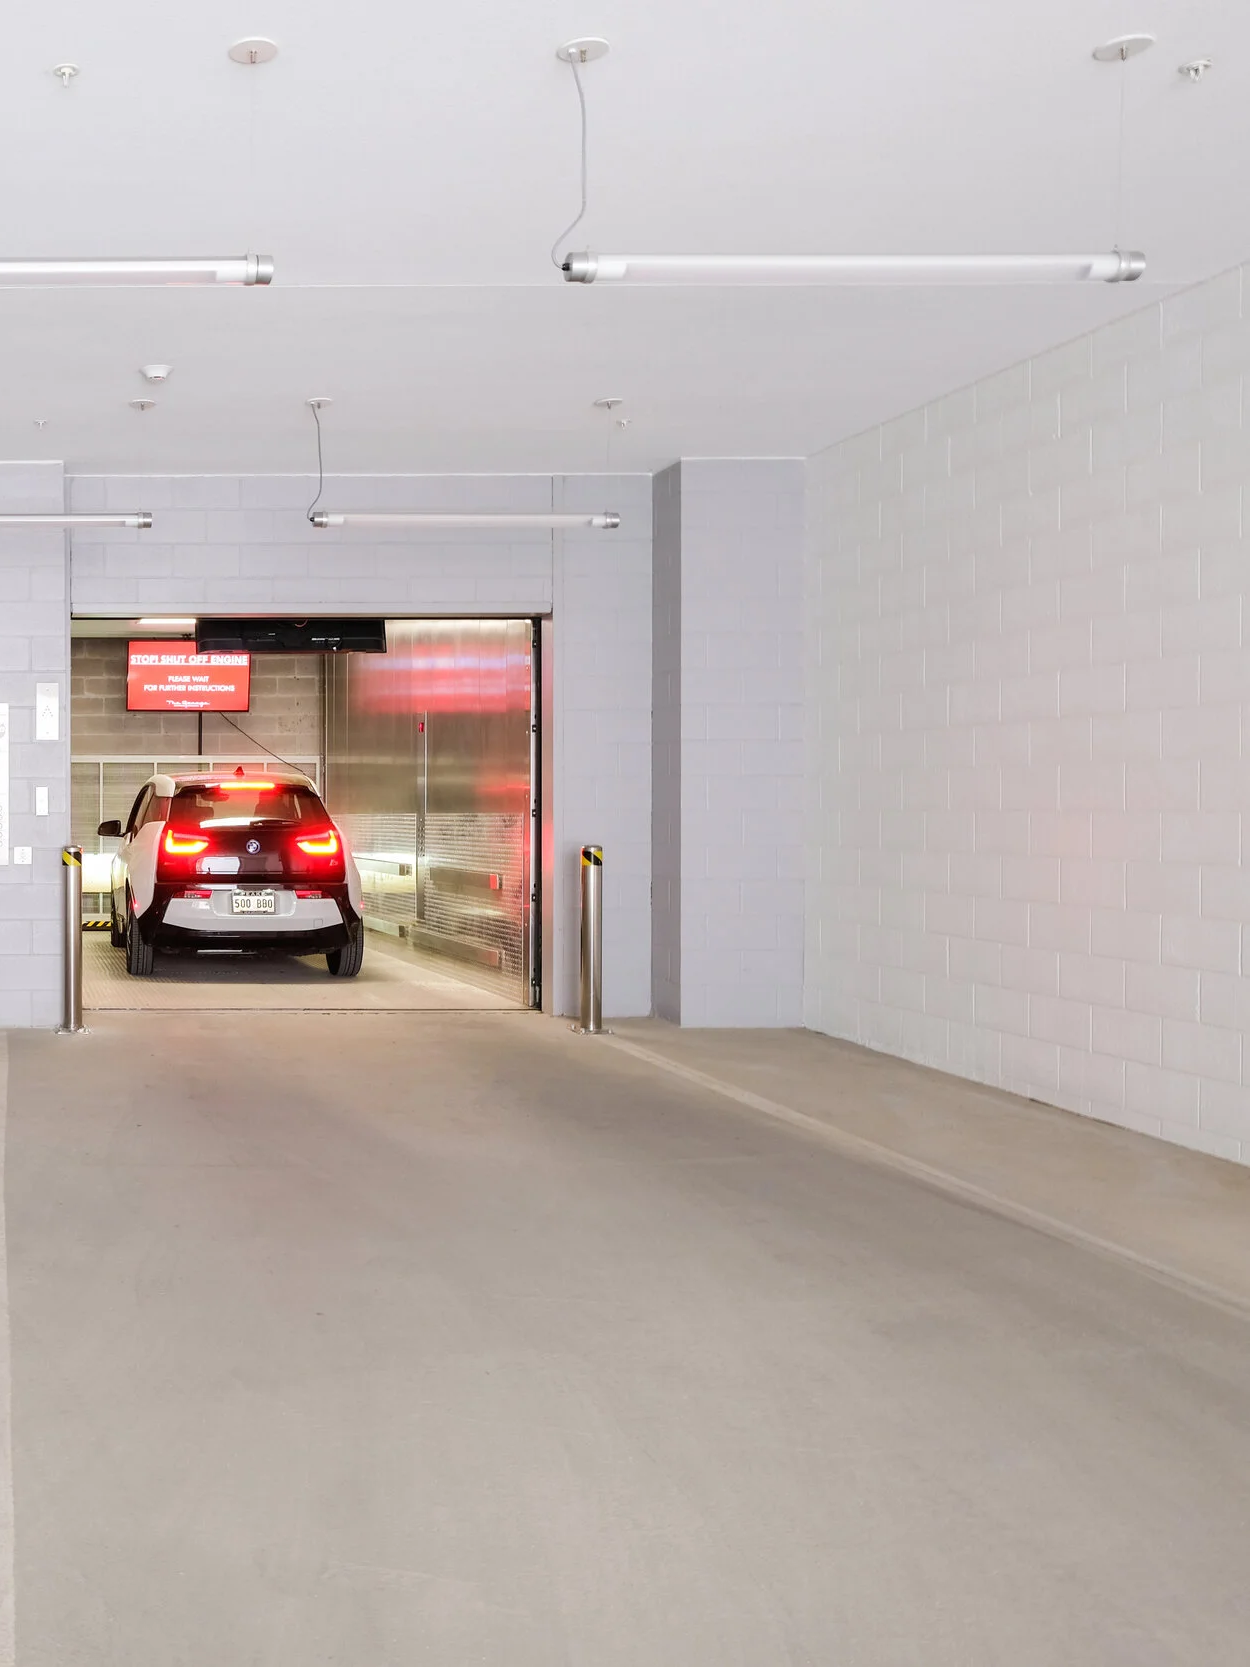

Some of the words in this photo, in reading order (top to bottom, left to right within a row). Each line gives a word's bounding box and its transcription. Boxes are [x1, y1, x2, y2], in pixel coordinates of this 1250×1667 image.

[130, 654, 158, 665] STOP!
[160, 654, 186, 665] SHUT
[188, 654, 209, 665] OFF
[210, 654, 248, 665] ENGINE
[167, 675, 191, 683] PLEASE
[191, 675, 210, 683] WAIT
[143, 684, 158, 692] FOR
[158, 684, 187, 692] FURTHER
[187, 684, 235, 692] INSTRUCTIONS
